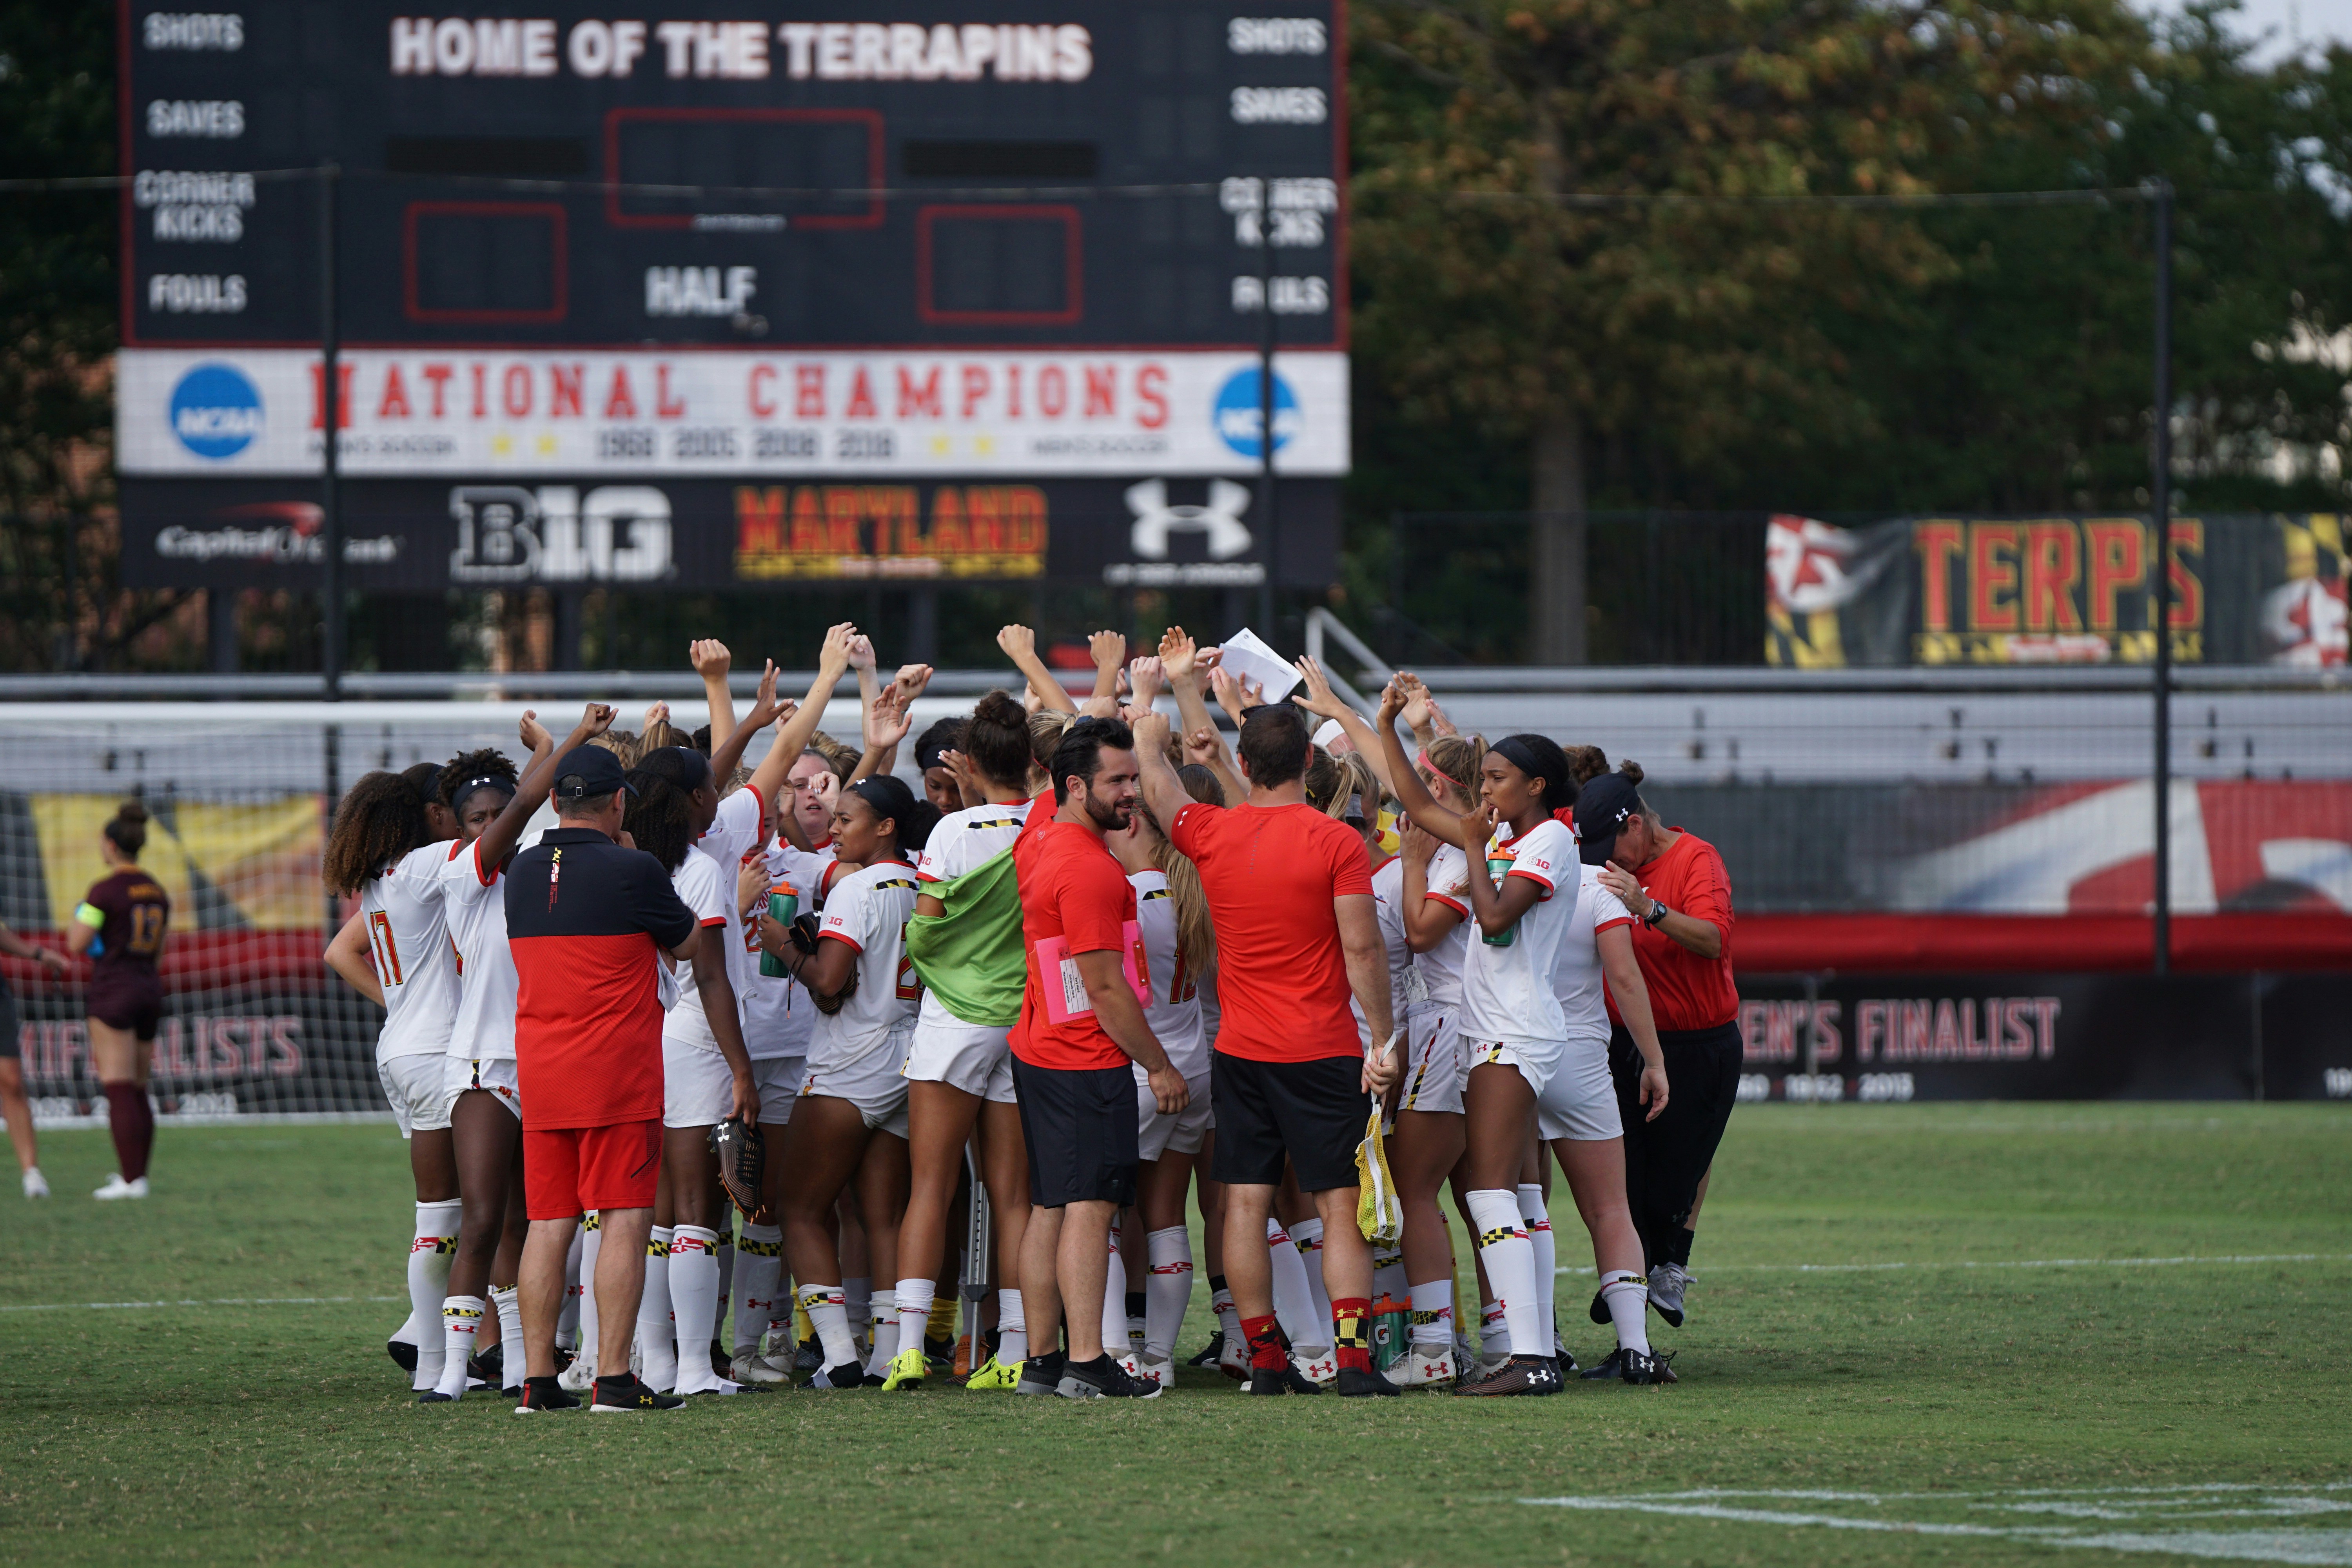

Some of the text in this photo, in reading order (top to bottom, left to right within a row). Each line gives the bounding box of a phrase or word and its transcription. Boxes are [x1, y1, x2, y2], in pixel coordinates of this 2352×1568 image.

[145, 13, 243, 49] SHOTS
[392, 18, 1092, 81] HOME OF THE TERRAPINS
[1229, 18, 1326, 54] SHOTS
[147, 100, 244, 136] SAVES
[1231, 87, 1327, 123] SAVES
[135, 171, 255, 206] CORNER
[154, 205, 242, 240] KICKS
[150, 274, 246, 311] FOULS
[646, 266, 755, 316] HALF
[310, 363, 1169, 429] NATIONAL CHAMPIONS
[734, 486, 1048, 555] MARYLAND
[1915, 519, 2203, 632] TERPS
[130, 904, 164, 953] 13
[370, 910, 403, 987] 17
[1856, 998, 2062, 1061] FINALIST
[1374, 1323, 1390, 1345] G
